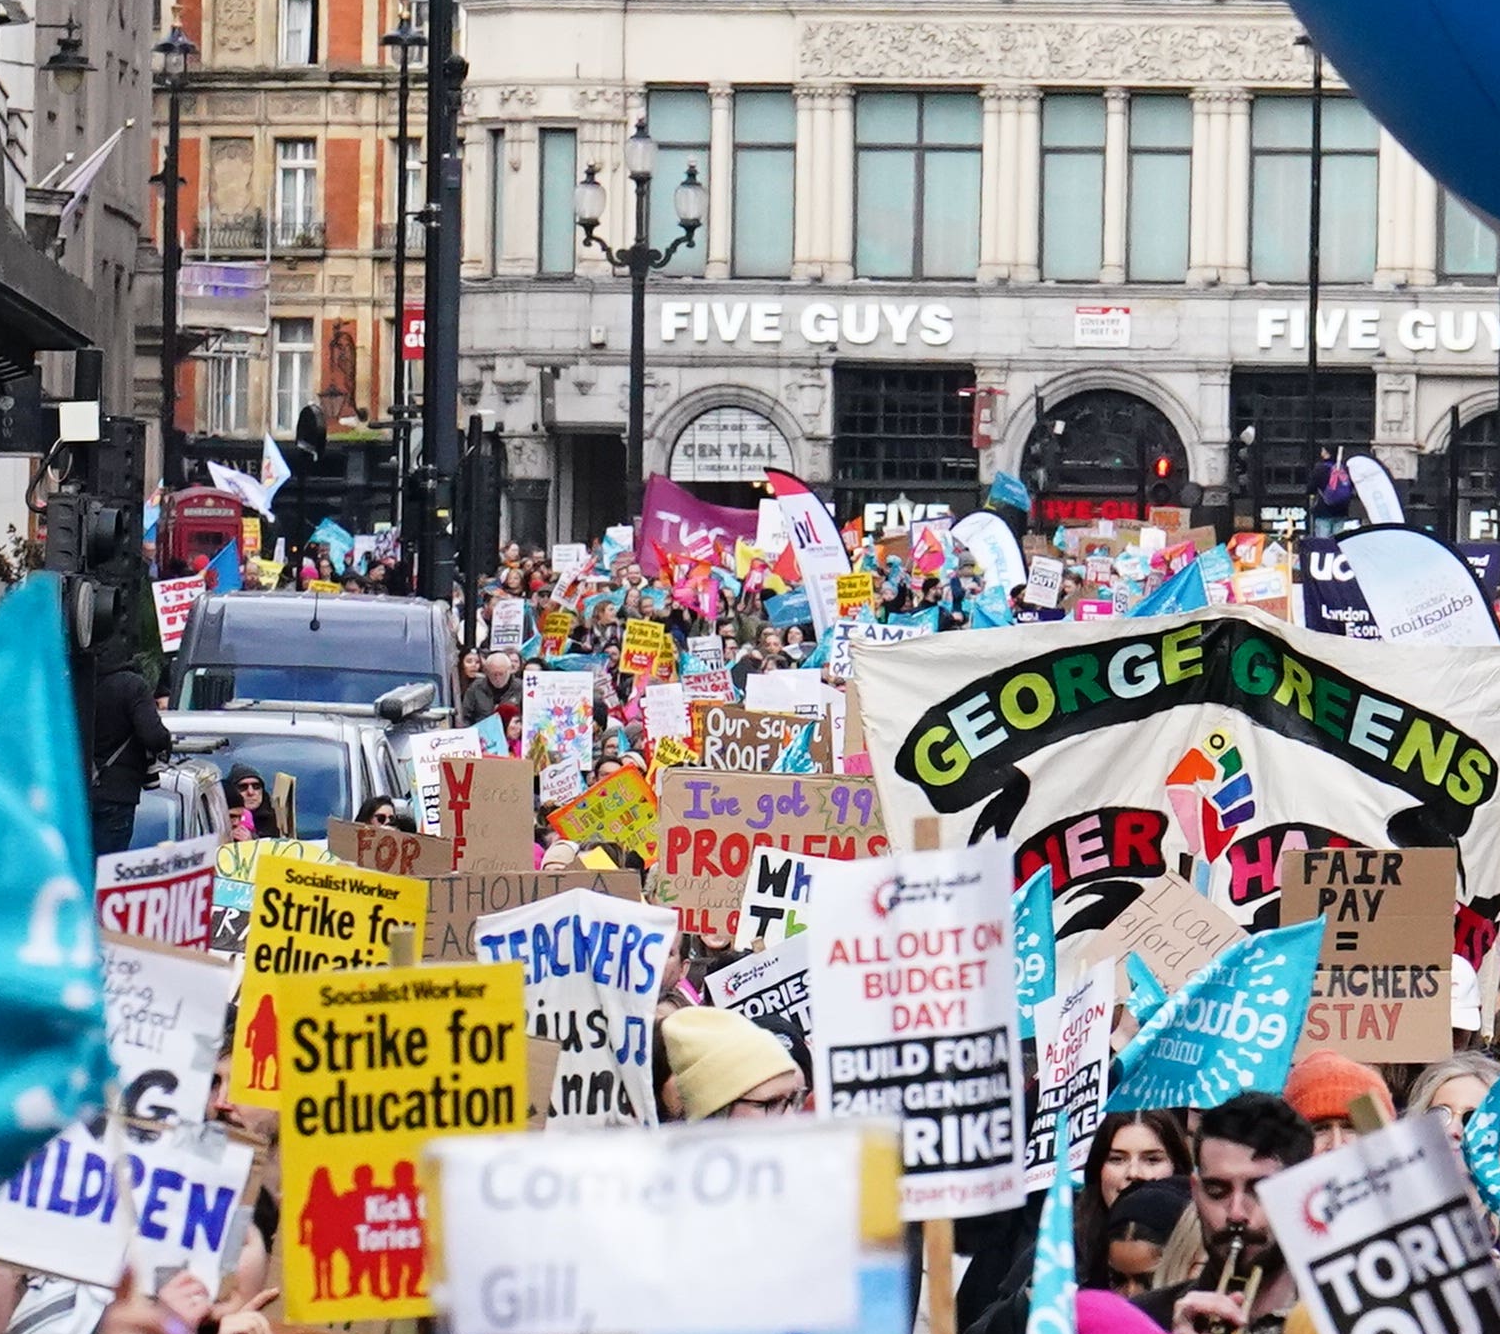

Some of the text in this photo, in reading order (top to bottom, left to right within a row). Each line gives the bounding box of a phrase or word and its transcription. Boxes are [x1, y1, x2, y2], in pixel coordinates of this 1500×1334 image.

[661, 301, 954, 344] FIVE GUYS
[1258, 308, 1381, 349] FIVE
[1309, 552, 1355, 581] UC
[913, 623, 1203, 787] GEORGE
[1228, 633, 1495, 807] GREENS
[704, 736, 768, 769] ROOF
[683, 780, 874, 829] I've got 99
[1305, 850, 1403, 886] FAIR
[102, 873, 211, 948] STRIKE
[1318, 888, 1385, 923] PAY
[480, 915, 664, 994] TEACHERS
[827, 923, 1004, 965] ALL OUT ON
[863, 961, 988, 999] BUDGET
[891, 998, 967, 1031] DAY!
[1306, 1003, 1402, 1043] STAY
[292, 1009, 514, 1075] Strike for
[830, 1034, 1011, 1081] BUILD FOR A
[292, 1075, 515, 1137] education
[831, 1072, 1012, 1117] 24HR GENERAL
[364, 1196, 408, 1225] Kick
[355, 1221, 421, 1253] Tories
